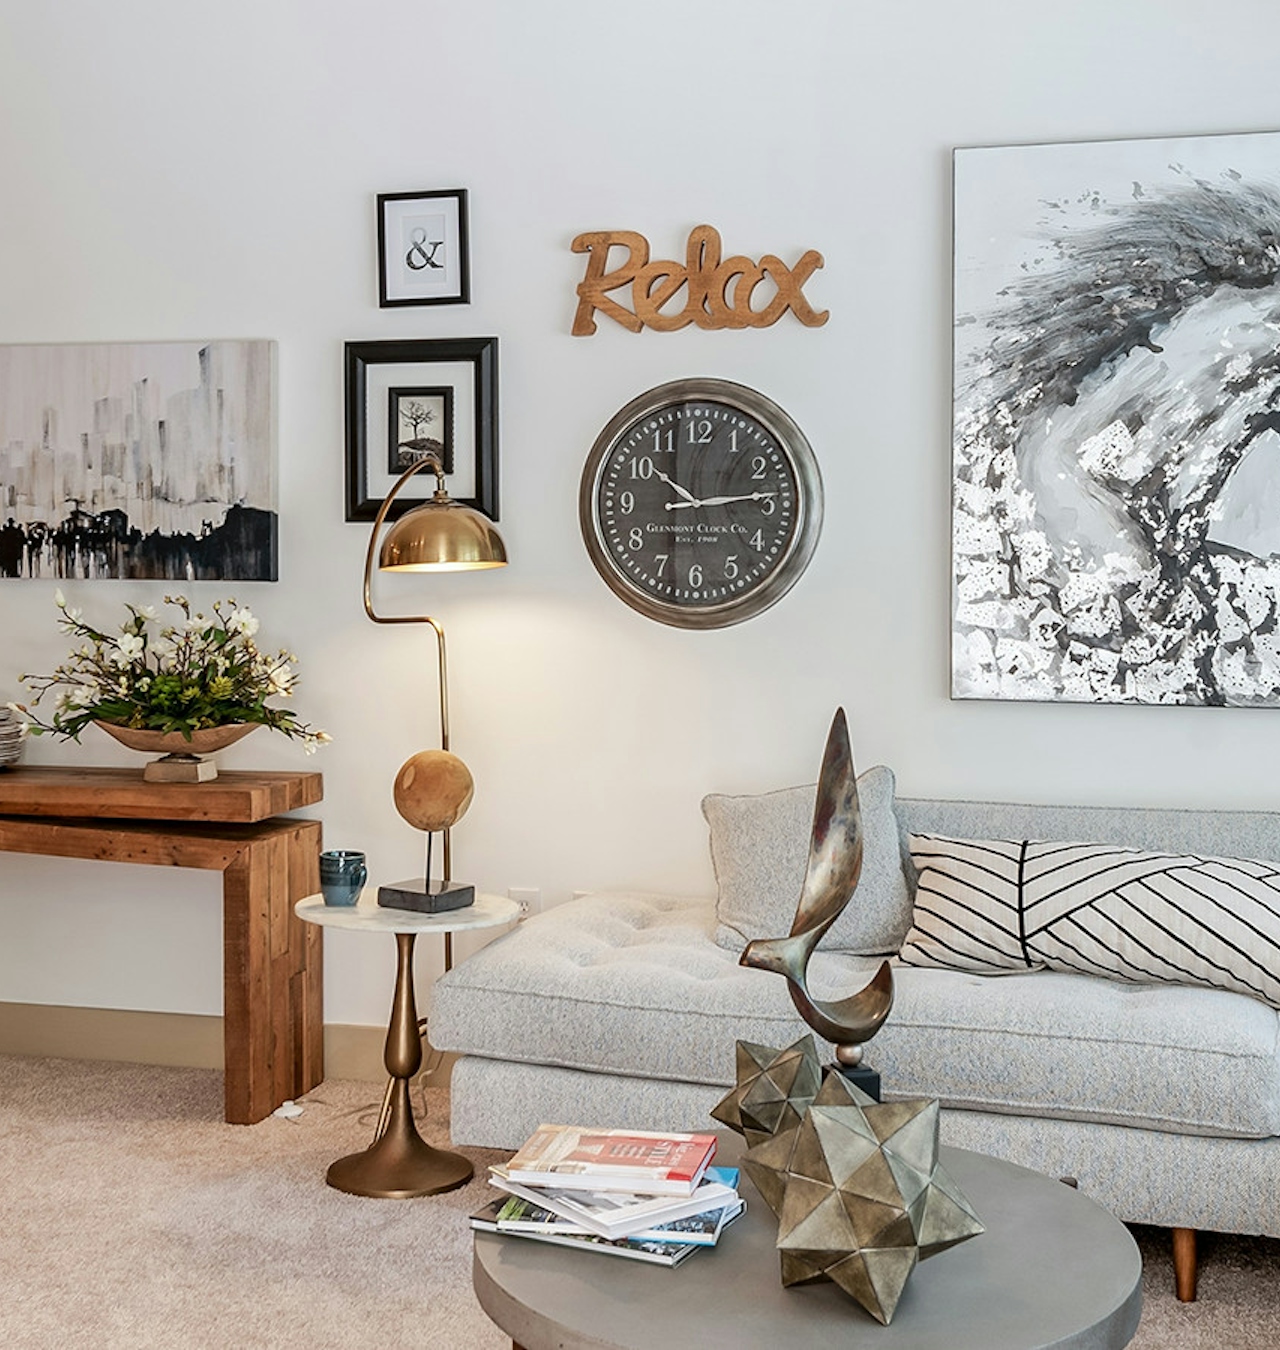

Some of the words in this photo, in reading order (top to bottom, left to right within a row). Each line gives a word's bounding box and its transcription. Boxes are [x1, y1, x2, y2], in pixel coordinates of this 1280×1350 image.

[406, 226, 444, 270] &
[571, 224, 830, 337] Relax
[651, 430, 675, 453] 11
[686, 420, 712, 444] 12
[728, 429, 739, 452] 1
[628, 456, 653, 480] 10
[751, 456, 767, 480] 2
[620, 491, 635, 515] 9
[760, 494, 776, 516] 3
[628, 527, 644, 551] 8
[646, 522, 694, 533] GLENMONT
[696, 522, 728, 533] CLOCK
[749, 529, 766, 553] 4
[654, 554, 669, 577] 7
[688, 564, 703, 588] 6
[723, 554, 739, 580] 5
